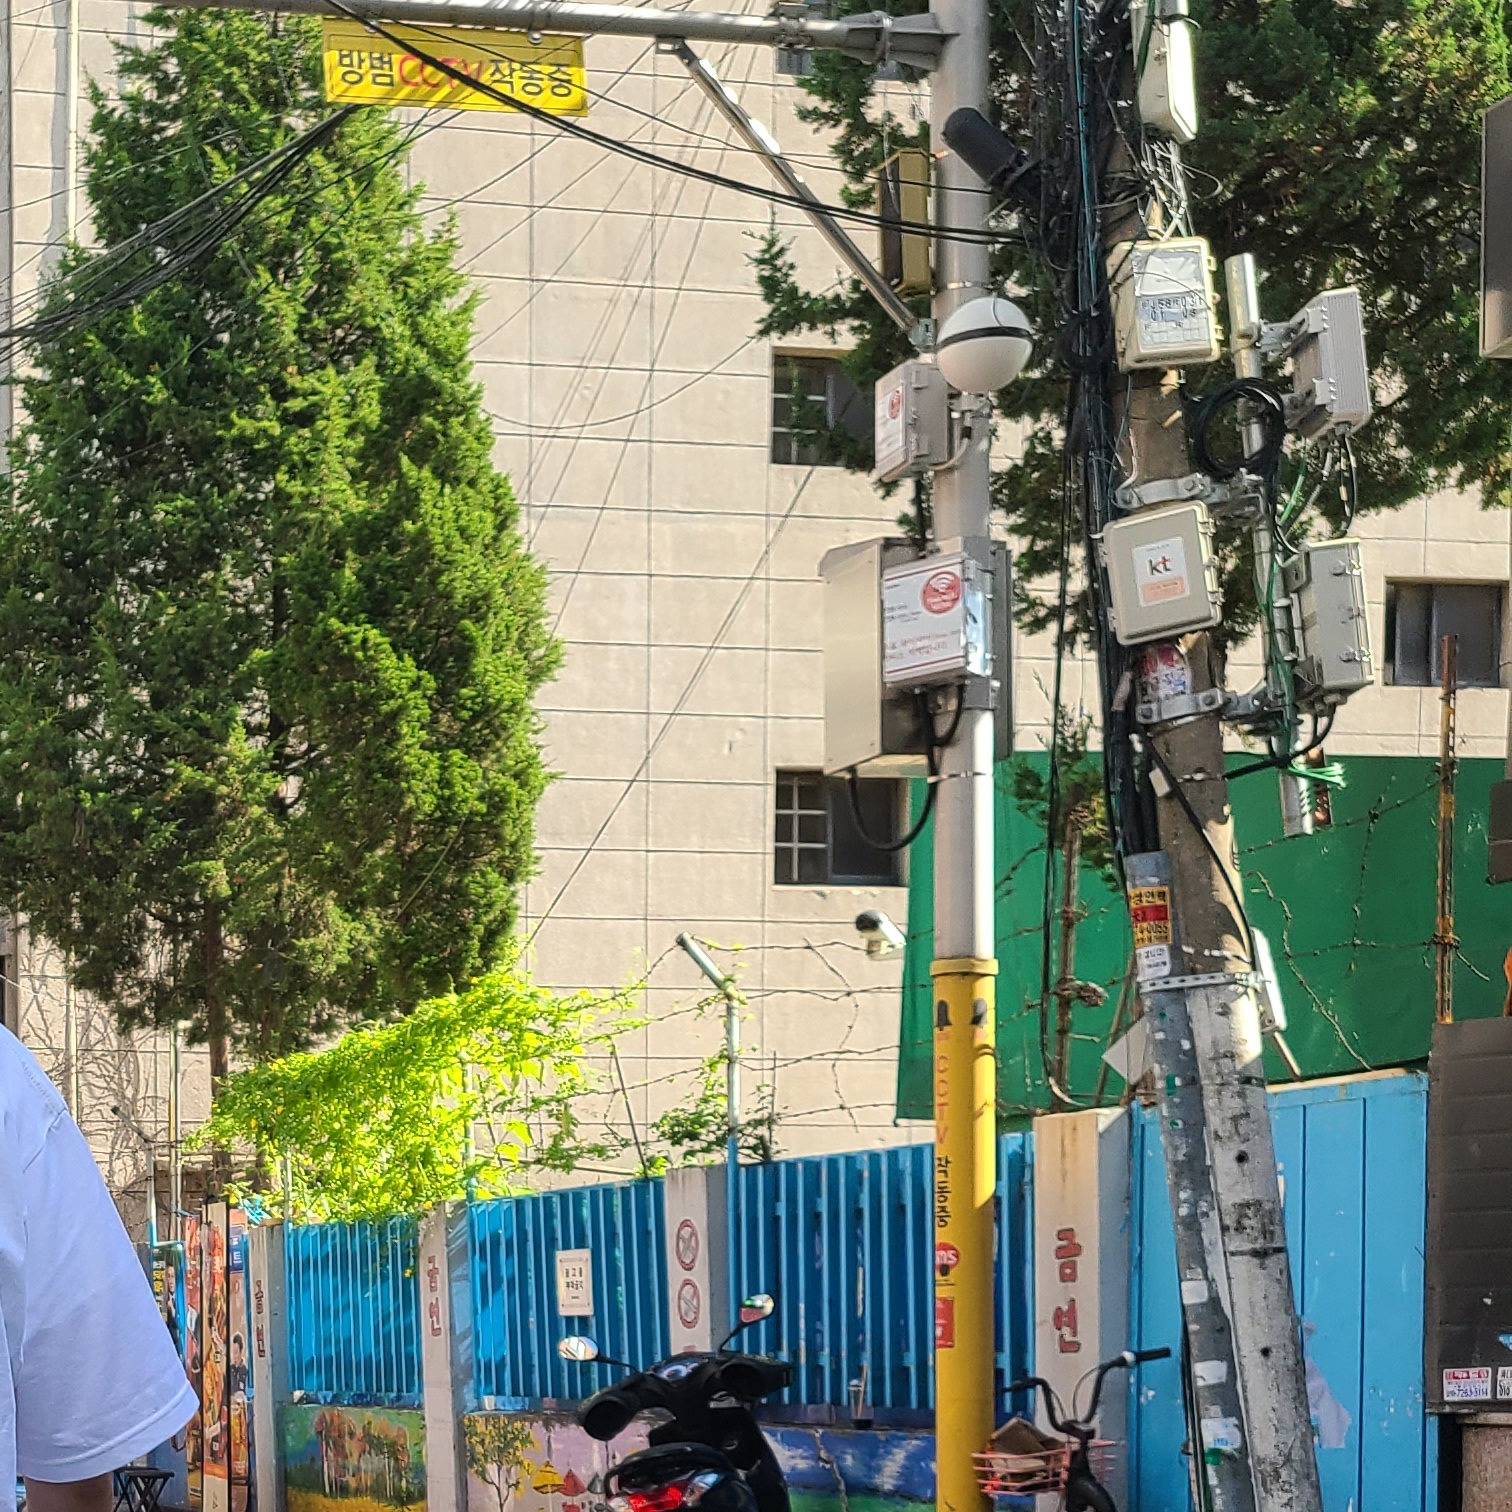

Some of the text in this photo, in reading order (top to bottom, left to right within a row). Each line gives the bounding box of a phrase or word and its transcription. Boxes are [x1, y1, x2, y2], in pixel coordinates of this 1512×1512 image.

[338, 50, 395, 87] 방범
[490, 59, 573, 98] 작동중
[1147, 556, 1173, 576] kt
[427, 1255, 442, 1337] 금연
[1054, 1227, 1082, 1353] 금연
